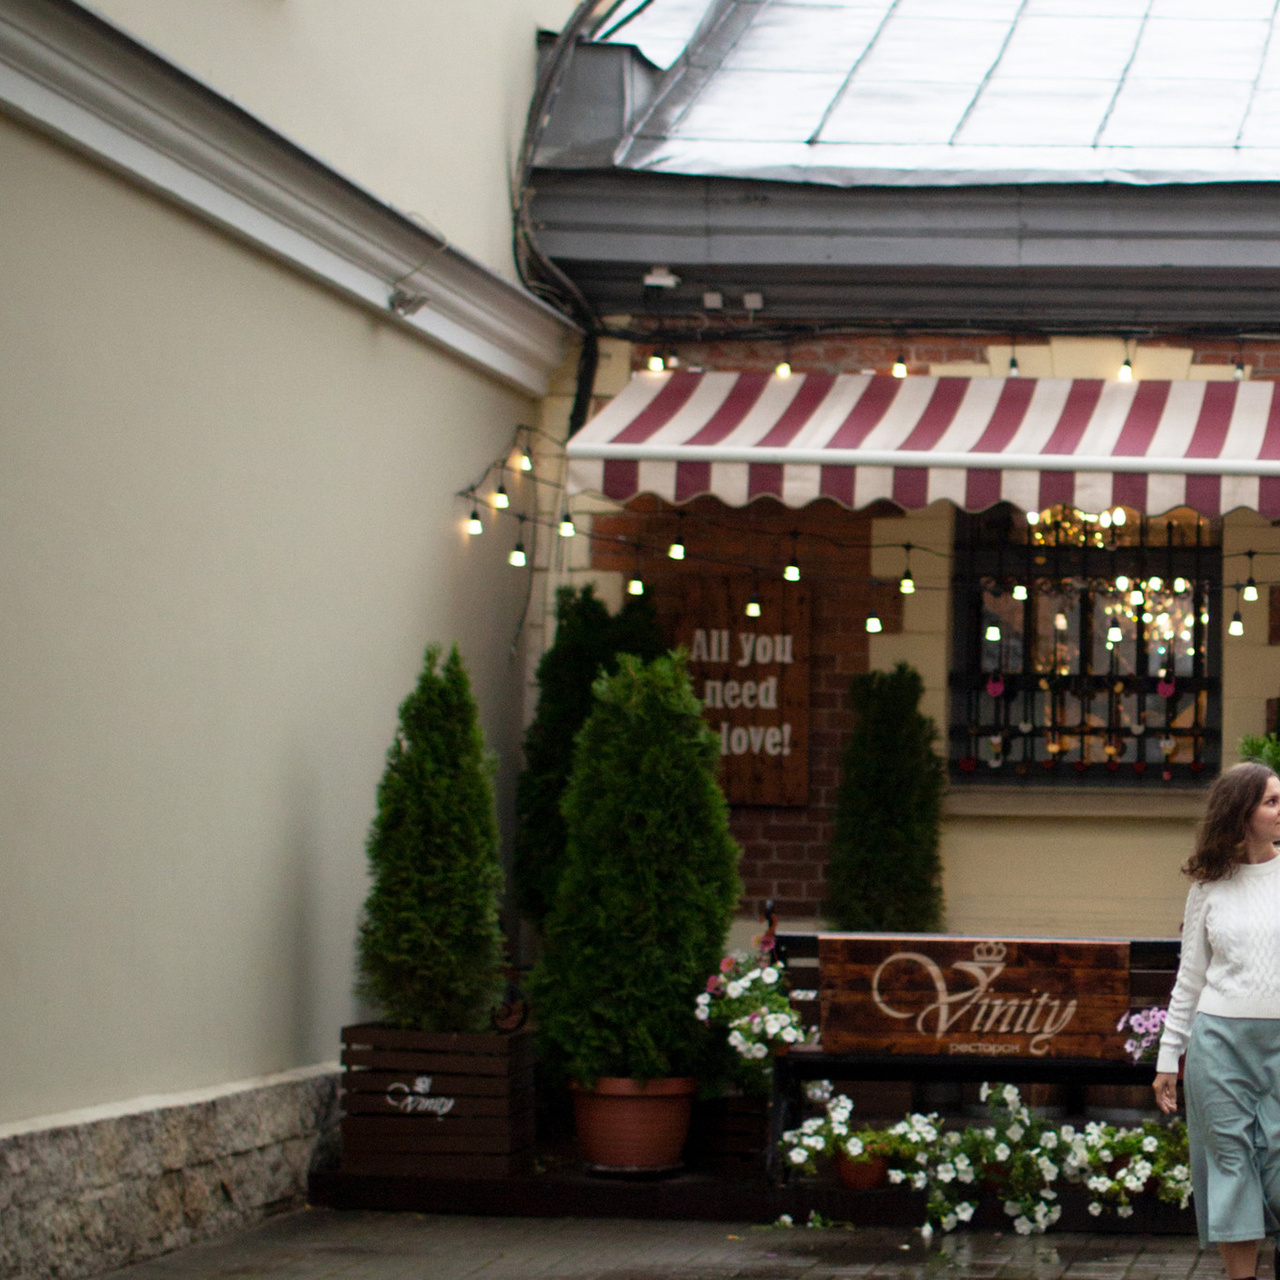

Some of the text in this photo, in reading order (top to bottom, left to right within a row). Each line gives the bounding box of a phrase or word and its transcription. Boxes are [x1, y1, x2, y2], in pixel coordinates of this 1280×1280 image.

[690, 629, 794, 668] All you
[704, 676, 778, 710] need
[720, 721, 792, 757] love!
[872, 951, 1078, 1055] Vinity
[949, 1041, 1020, 1055] ресторан
